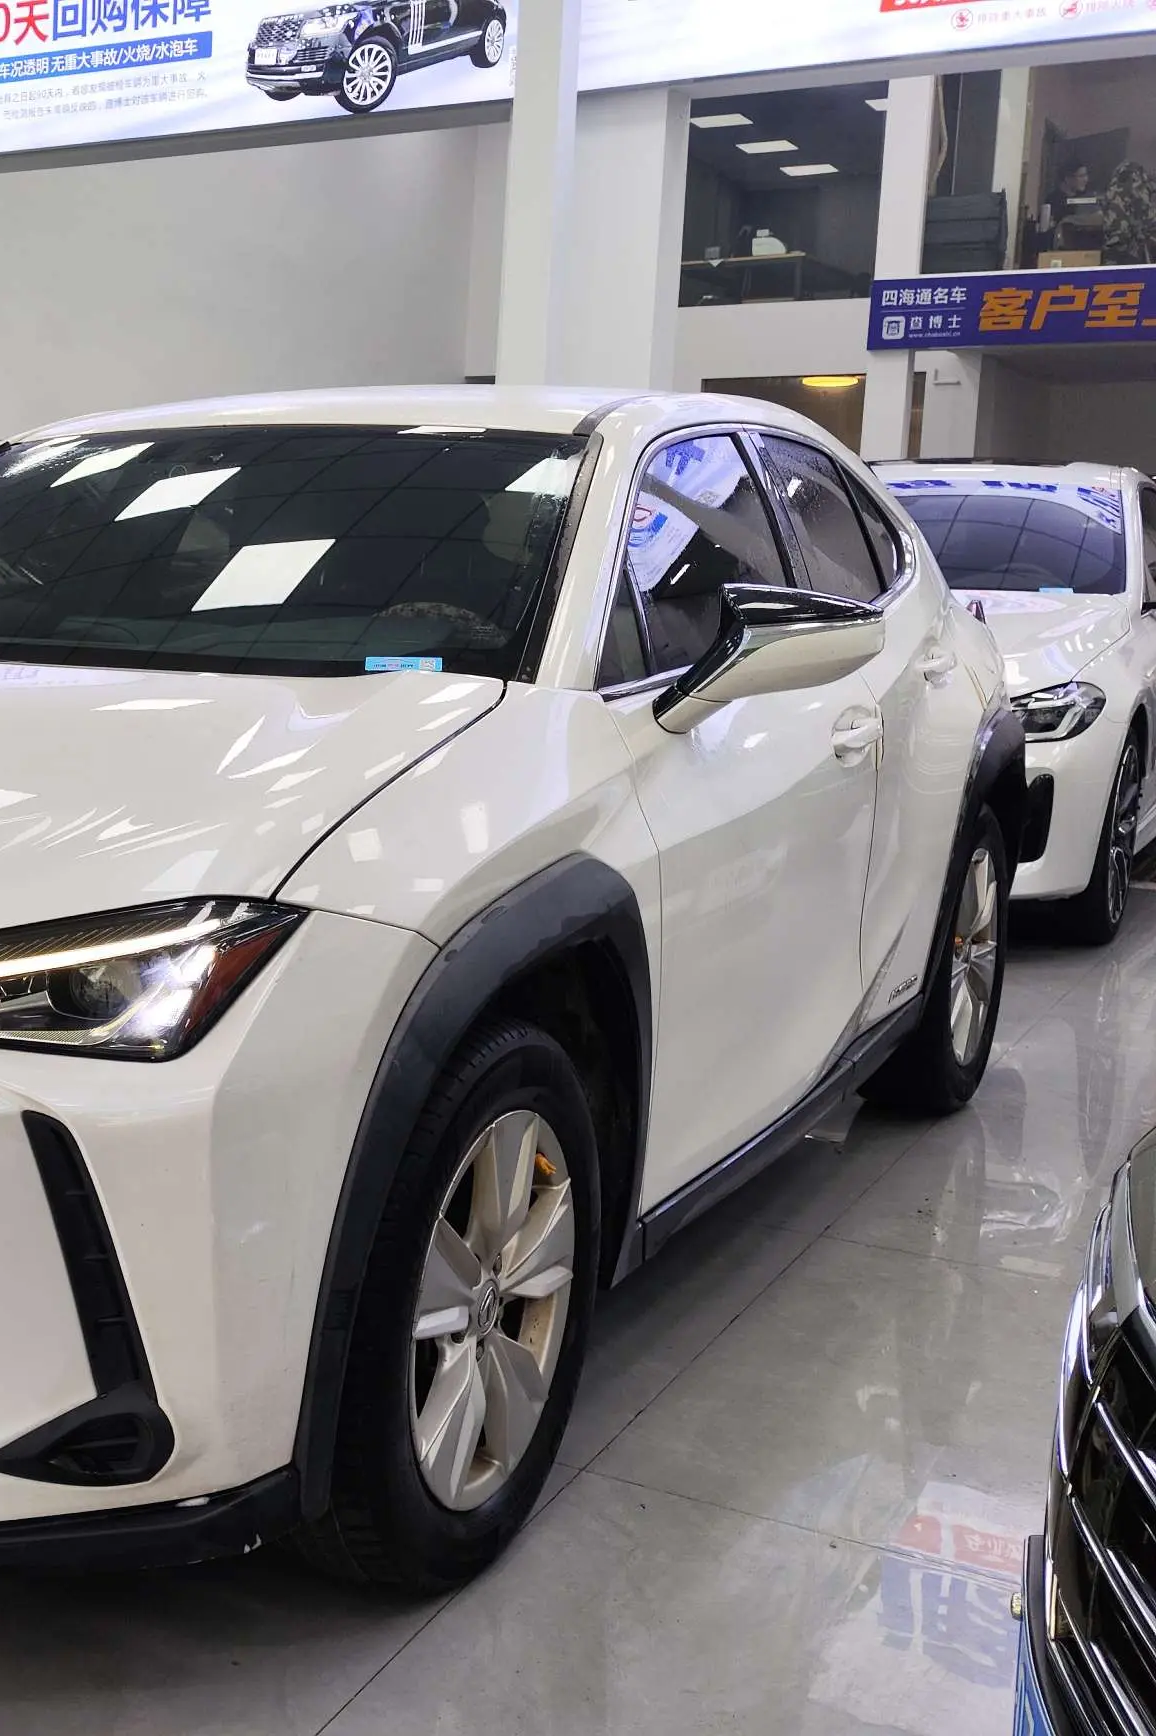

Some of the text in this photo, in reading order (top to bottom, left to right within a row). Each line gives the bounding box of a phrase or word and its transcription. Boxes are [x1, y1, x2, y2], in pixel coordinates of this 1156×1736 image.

[50, 38, 198, 73] 无重大事故/火烧/水泡车
[881, 286, 967, 307] 四海通名车
[978, 282, 1156, 332] 客户至
